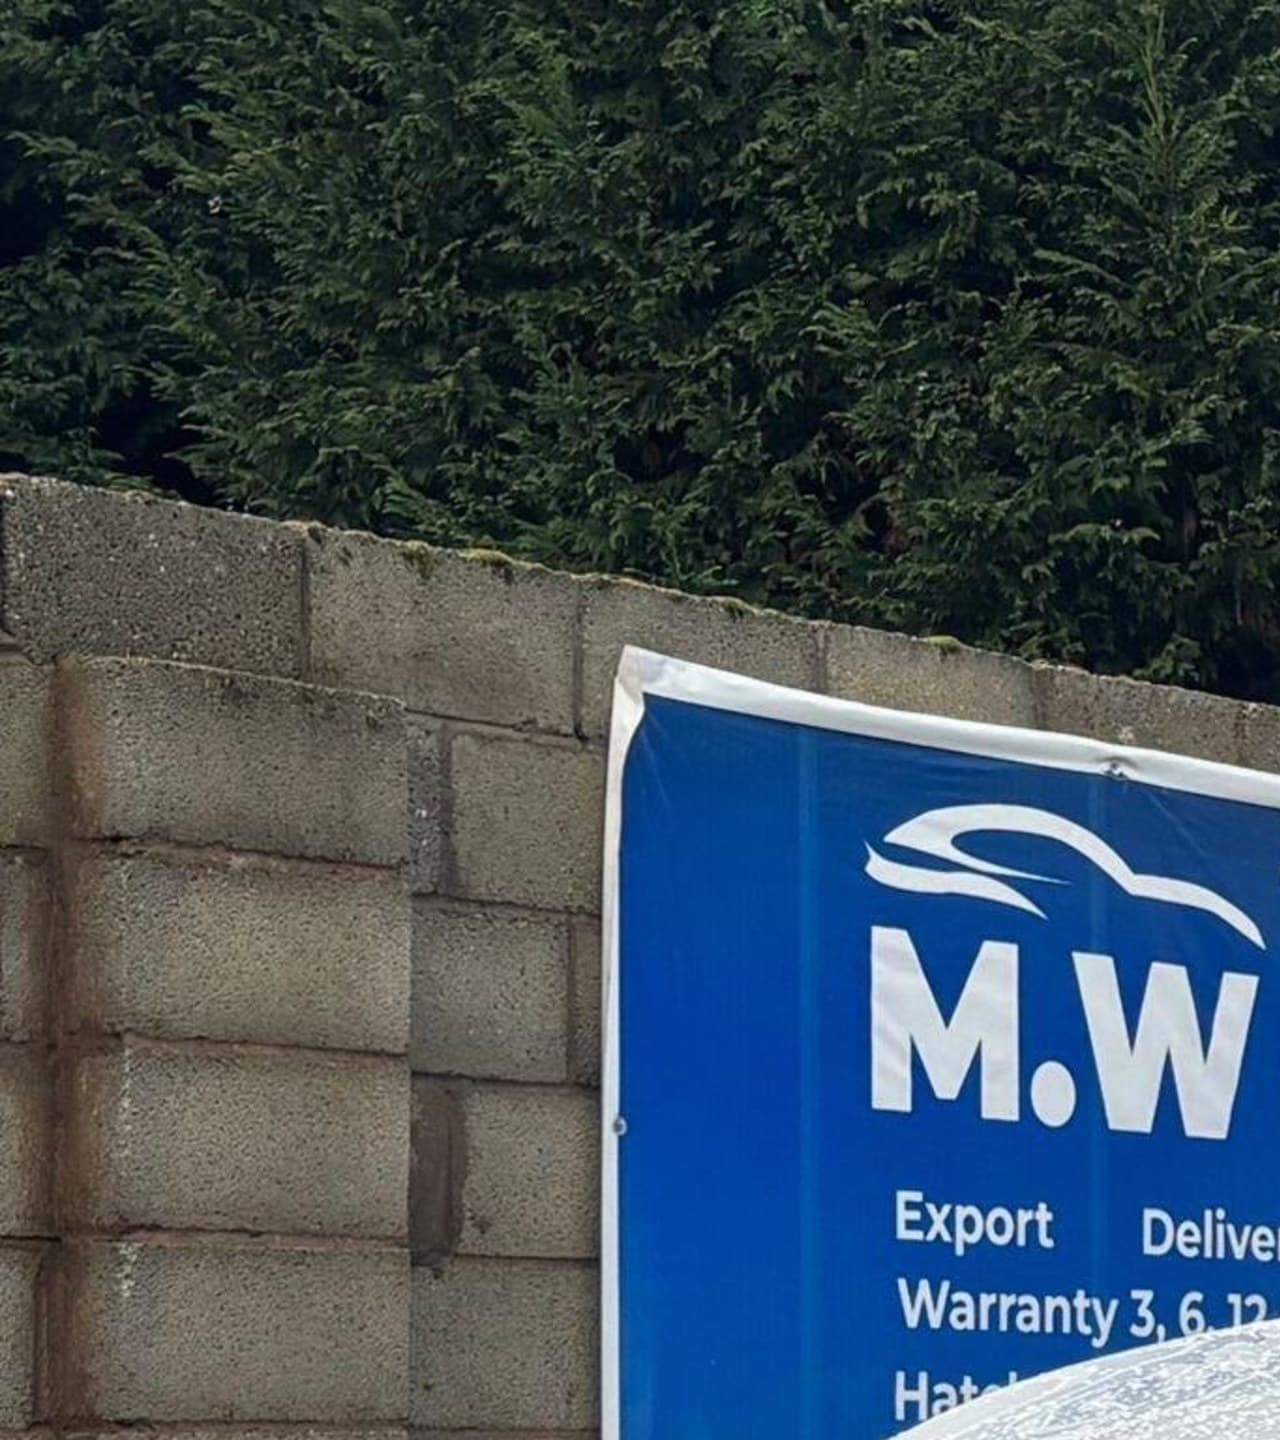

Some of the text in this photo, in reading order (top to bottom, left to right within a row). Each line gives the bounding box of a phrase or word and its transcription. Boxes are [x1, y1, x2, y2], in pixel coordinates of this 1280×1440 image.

[868, 926, 1260, 1140] M.W
[894, 1189, 1055, 1257] Export
[896, 1277, 1119, 1348] Warranty
[1129, 1288, 1166, 1344] 3,
[894, 1369, 1018, 1422] Hat
